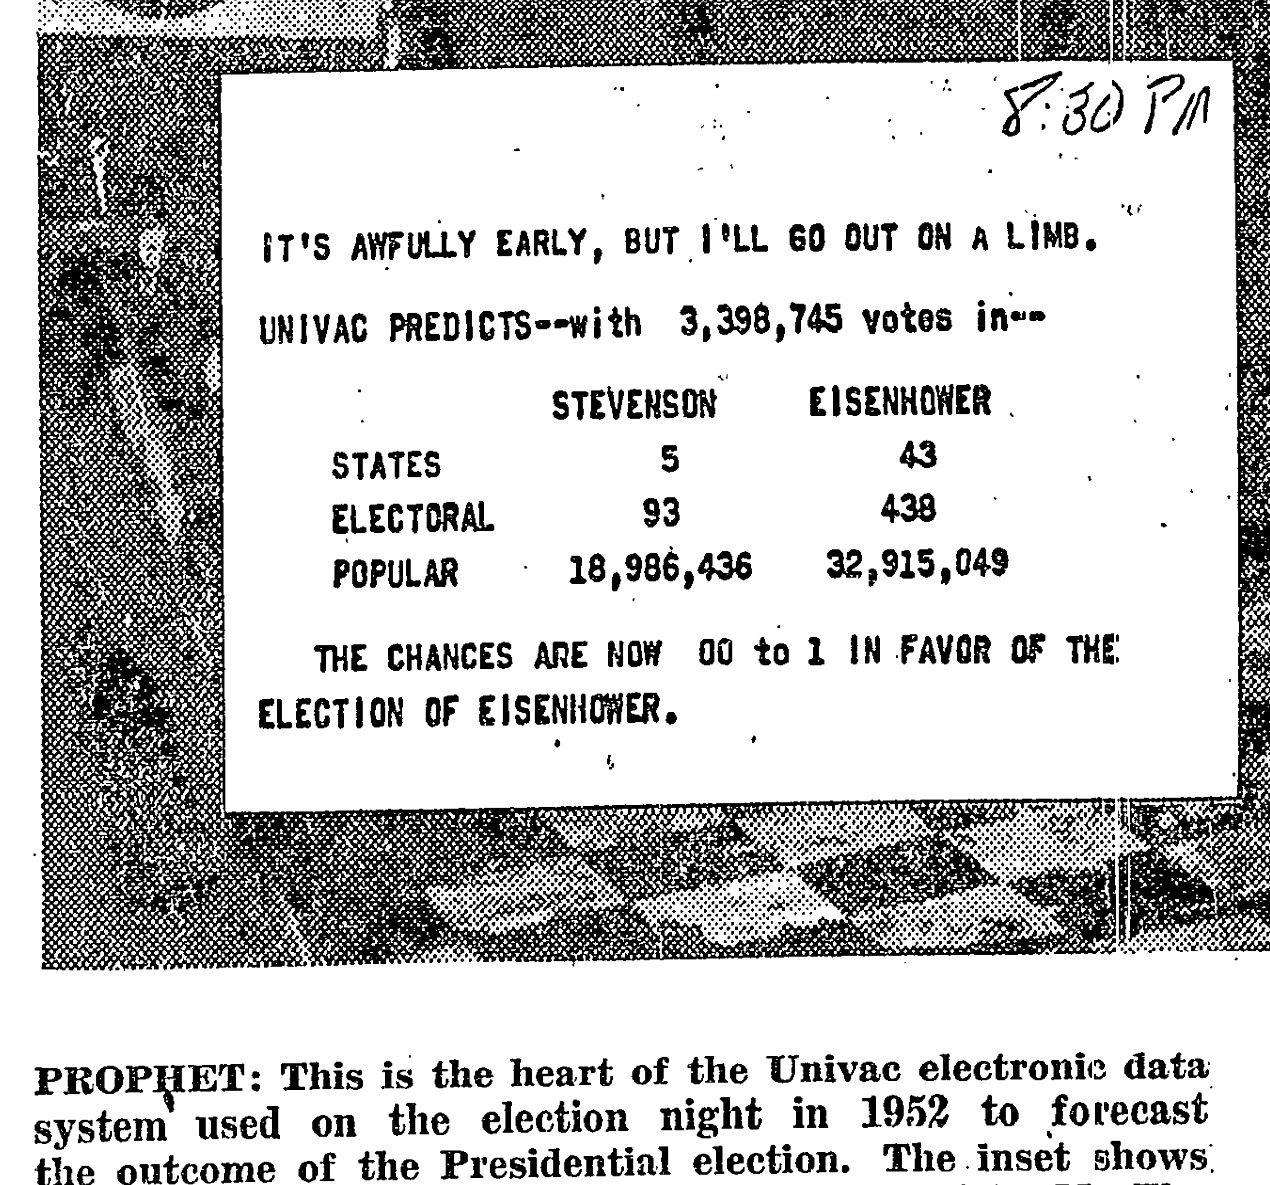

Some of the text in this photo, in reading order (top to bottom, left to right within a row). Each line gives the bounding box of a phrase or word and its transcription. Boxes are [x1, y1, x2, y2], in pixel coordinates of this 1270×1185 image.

[1002, 71, 1124, 137] 8:30
[264, 220, 1097, 264] IT'S AWFULLY EARLY, BUT I'LL GO OUT ON A LIMB.
[259, 313, 367, 345] UNIVAC
[680, 302, 842, 343] 3,398,745
[862, 302, 953, 334] votes
[552, 384, 992, 421] STEVENSON EISENHOWER
[332, 440, 937, 480] STATES 5 43
[332, 493, 937, 534] ELECTORAL 93 438
[333, 547, 1009, 591] POPULAR 18,986,436 32,915,049
[314, 644, 367, 673] THE
[388, 642, 513, 672] CHANCES
[534, 641, 588, 669] ARE
[608, 640, 662, 668] NOW
[754, 637, 790, 665] to
[808, 637, 825, 665] 1
[850, 634, 880, 664] IN
[901, 634, 992, 664] FAVOR
[1011, 633, 1046, 664] OF
[1066, 633, 1117, 664] THE
[259, 692, 678, 730] ELECTION OF EISENHOWER.
